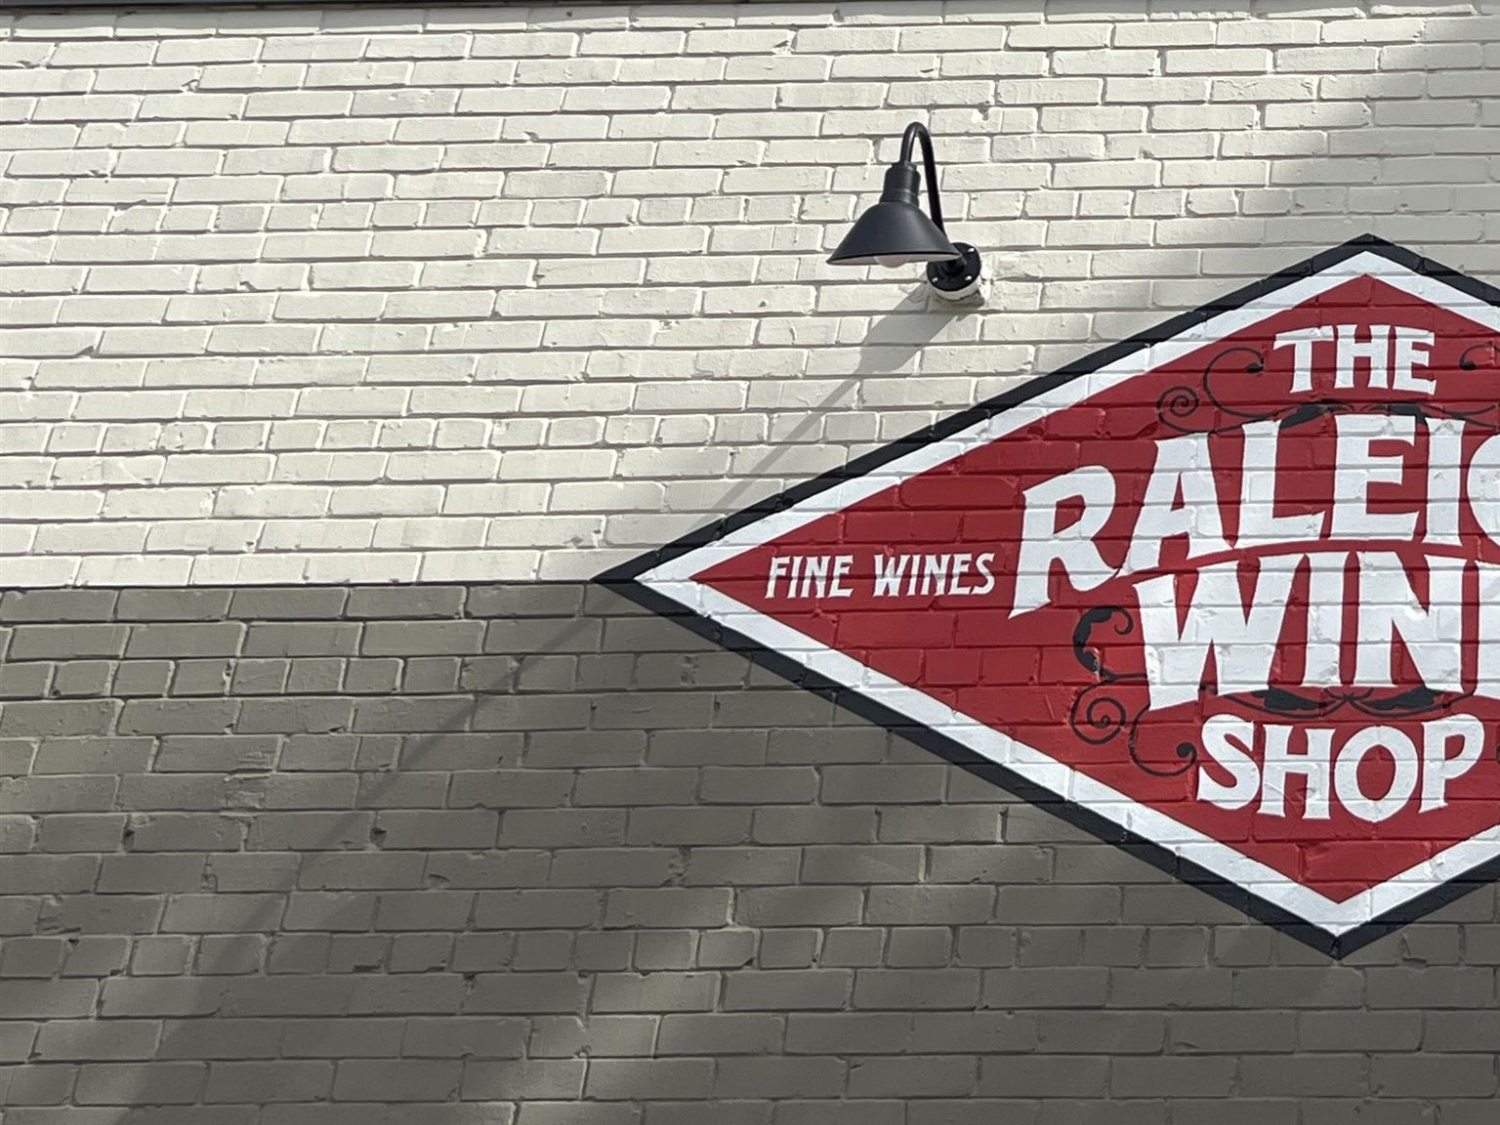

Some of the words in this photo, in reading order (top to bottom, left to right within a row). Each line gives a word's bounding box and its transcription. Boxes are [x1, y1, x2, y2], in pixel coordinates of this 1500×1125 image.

[1274, 325, 1437, 395] THE
[765, 555, 854, 598] FINE
[872, 553, 996, 597] WINES
[1196, 714, 1485, 823] SHOP
